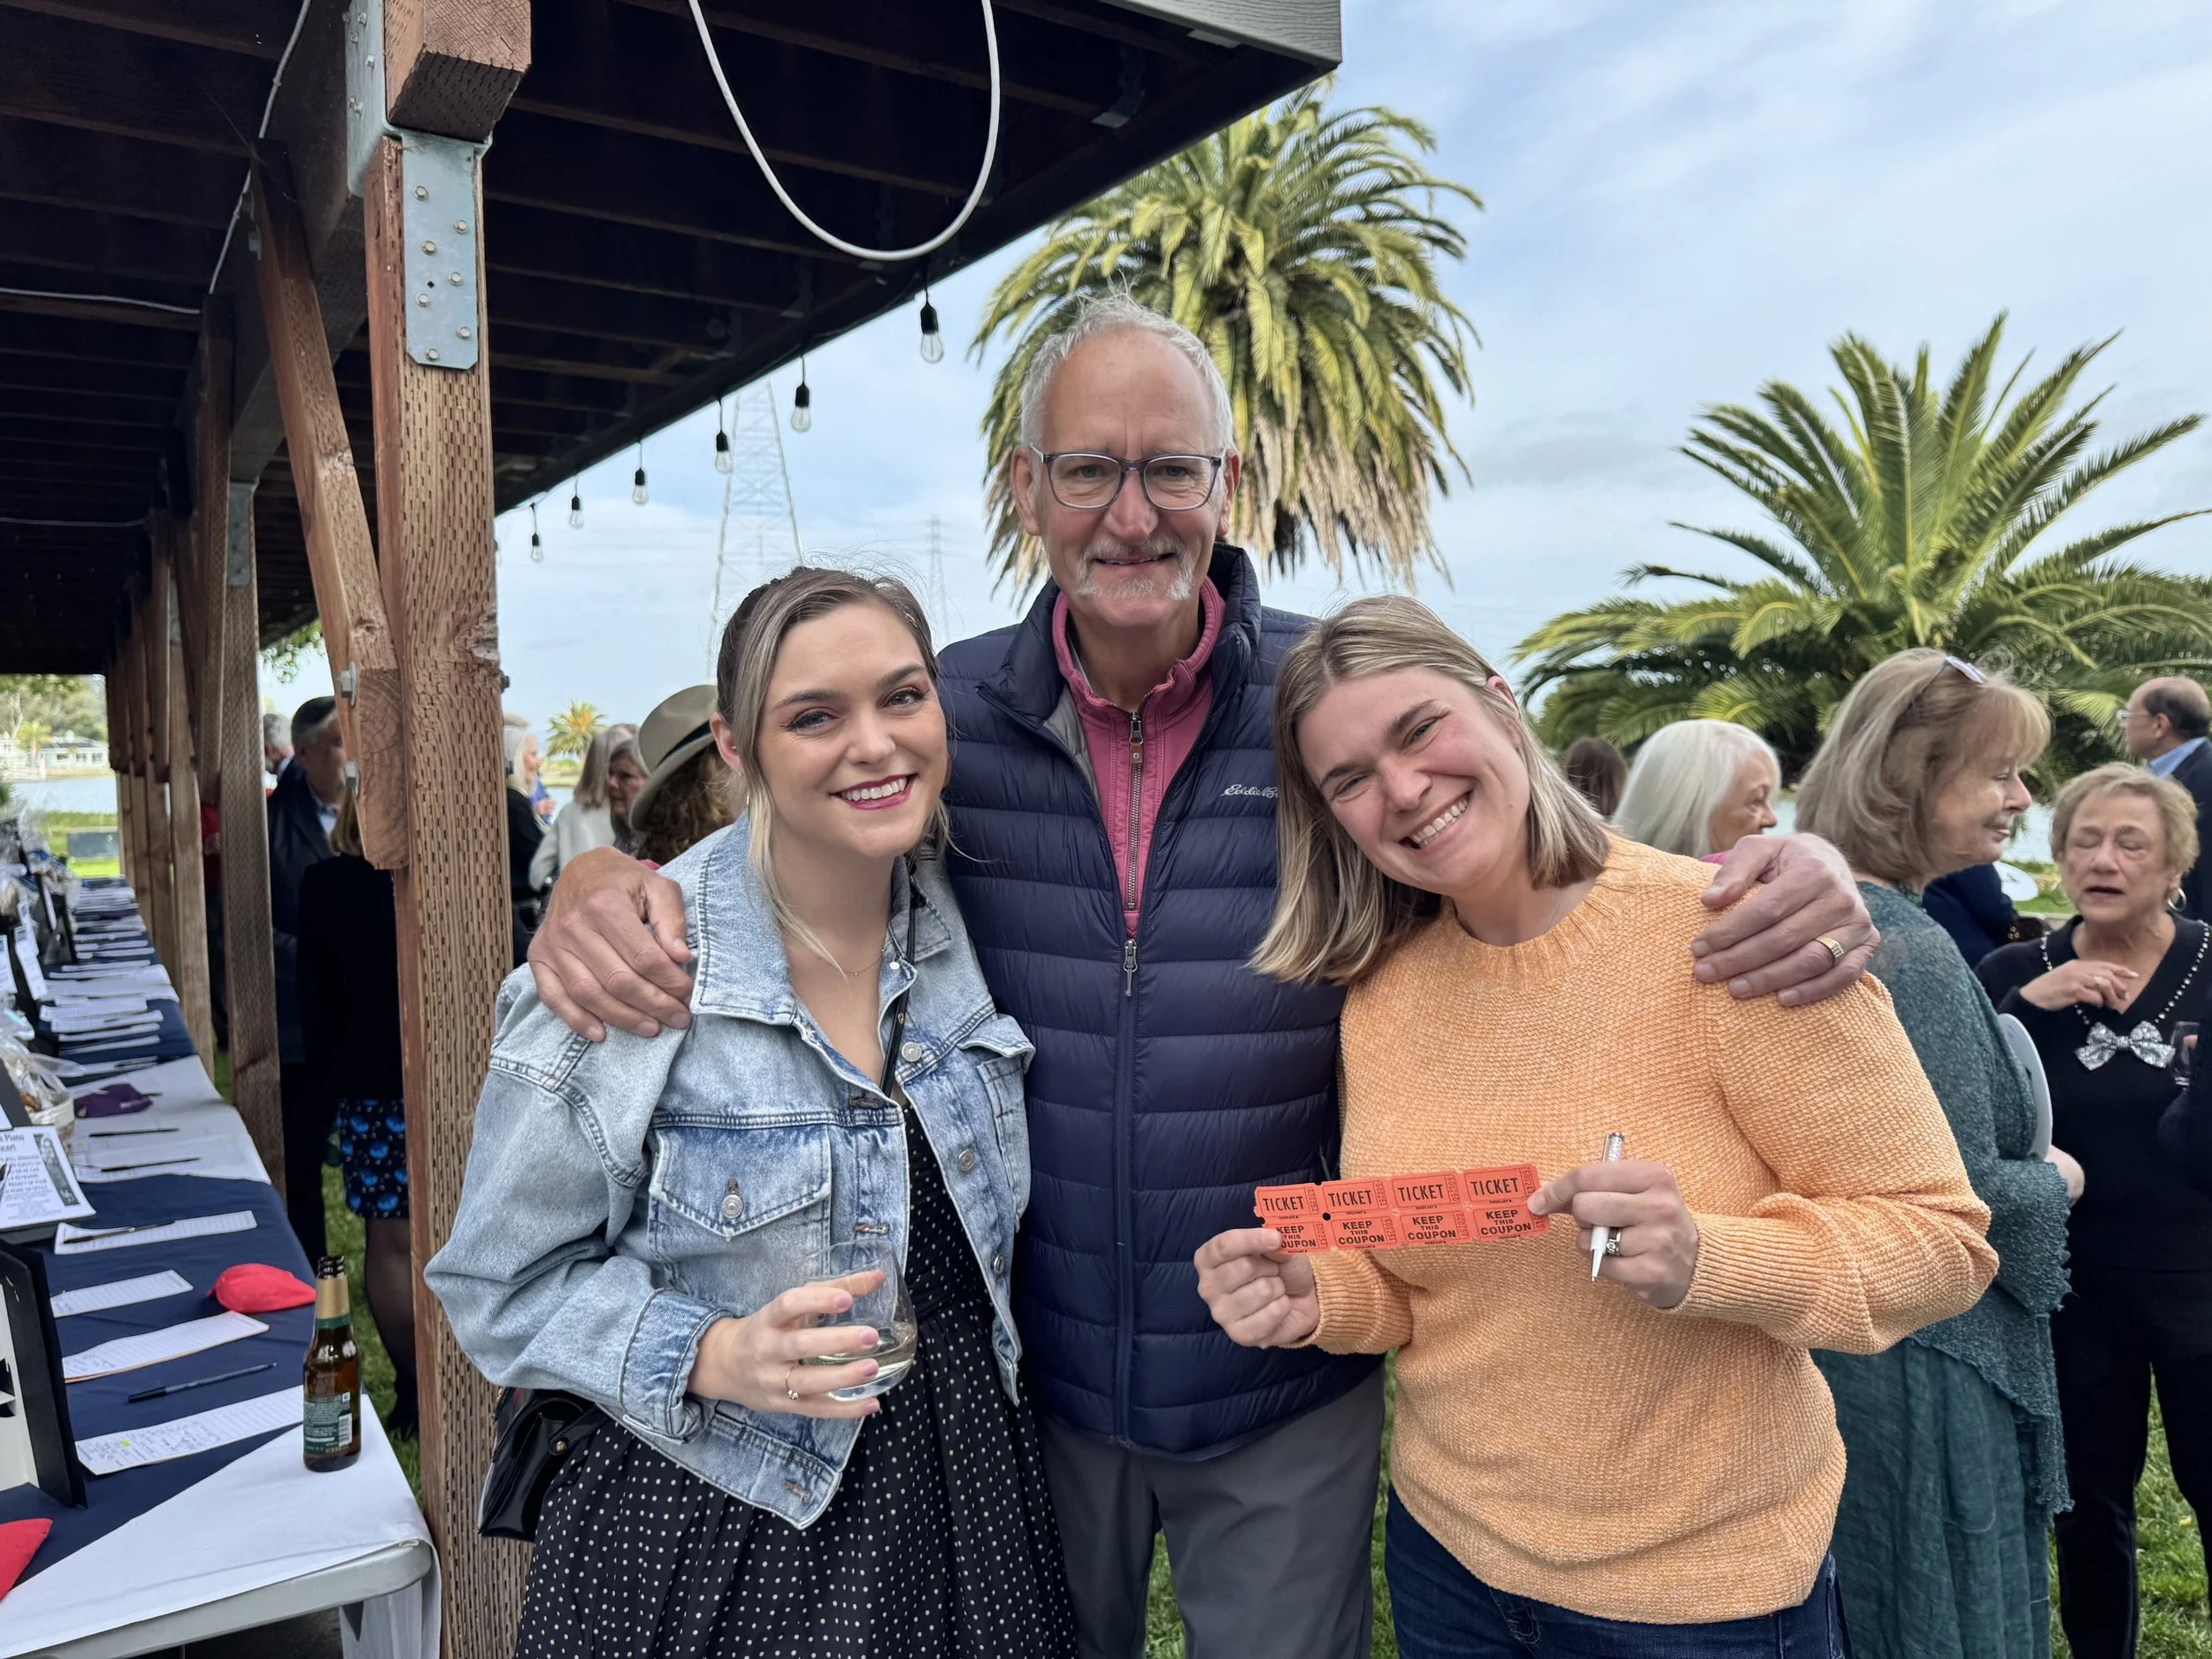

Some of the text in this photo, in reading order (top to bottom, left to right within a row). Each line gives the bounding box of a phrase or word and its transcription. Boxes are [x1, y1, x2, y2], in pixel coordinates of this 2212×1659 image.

[1220, 784, 1263, 796] Eddie
[1398, 1184, 1444, 1202] TICKET
[1448, 1177, 1460, 1202] 600250
[1471, 1177, 1518, 1196] TICKET
[1307, 1187, 1319, 1212] 600252
[1328, 1190, 1372, 1207] TICKET
[1376, 1183, 1388, 1207] 600251
[1263, 1196, 1303, 1211] TICKET
[1412, 1215, 1443, 1225] KEEP
[1486, 1210, 1518, 1219] KEEP
[1277, 1225, 1304, 1234] KEEP
[1343, 1220, 1372, 1230] KEEP
[1384, 1218, 1396, 1241] 600251
[1481, 1223, 1532, 1235] COUPON
[1316, 1223, 1329, 1247] 600252
[1338, 1235, 1385, 1245] COUPON
[1408, 1230, 1456, 1240] COUPON
[1281, 1239, 1317, 1248] OUPON
